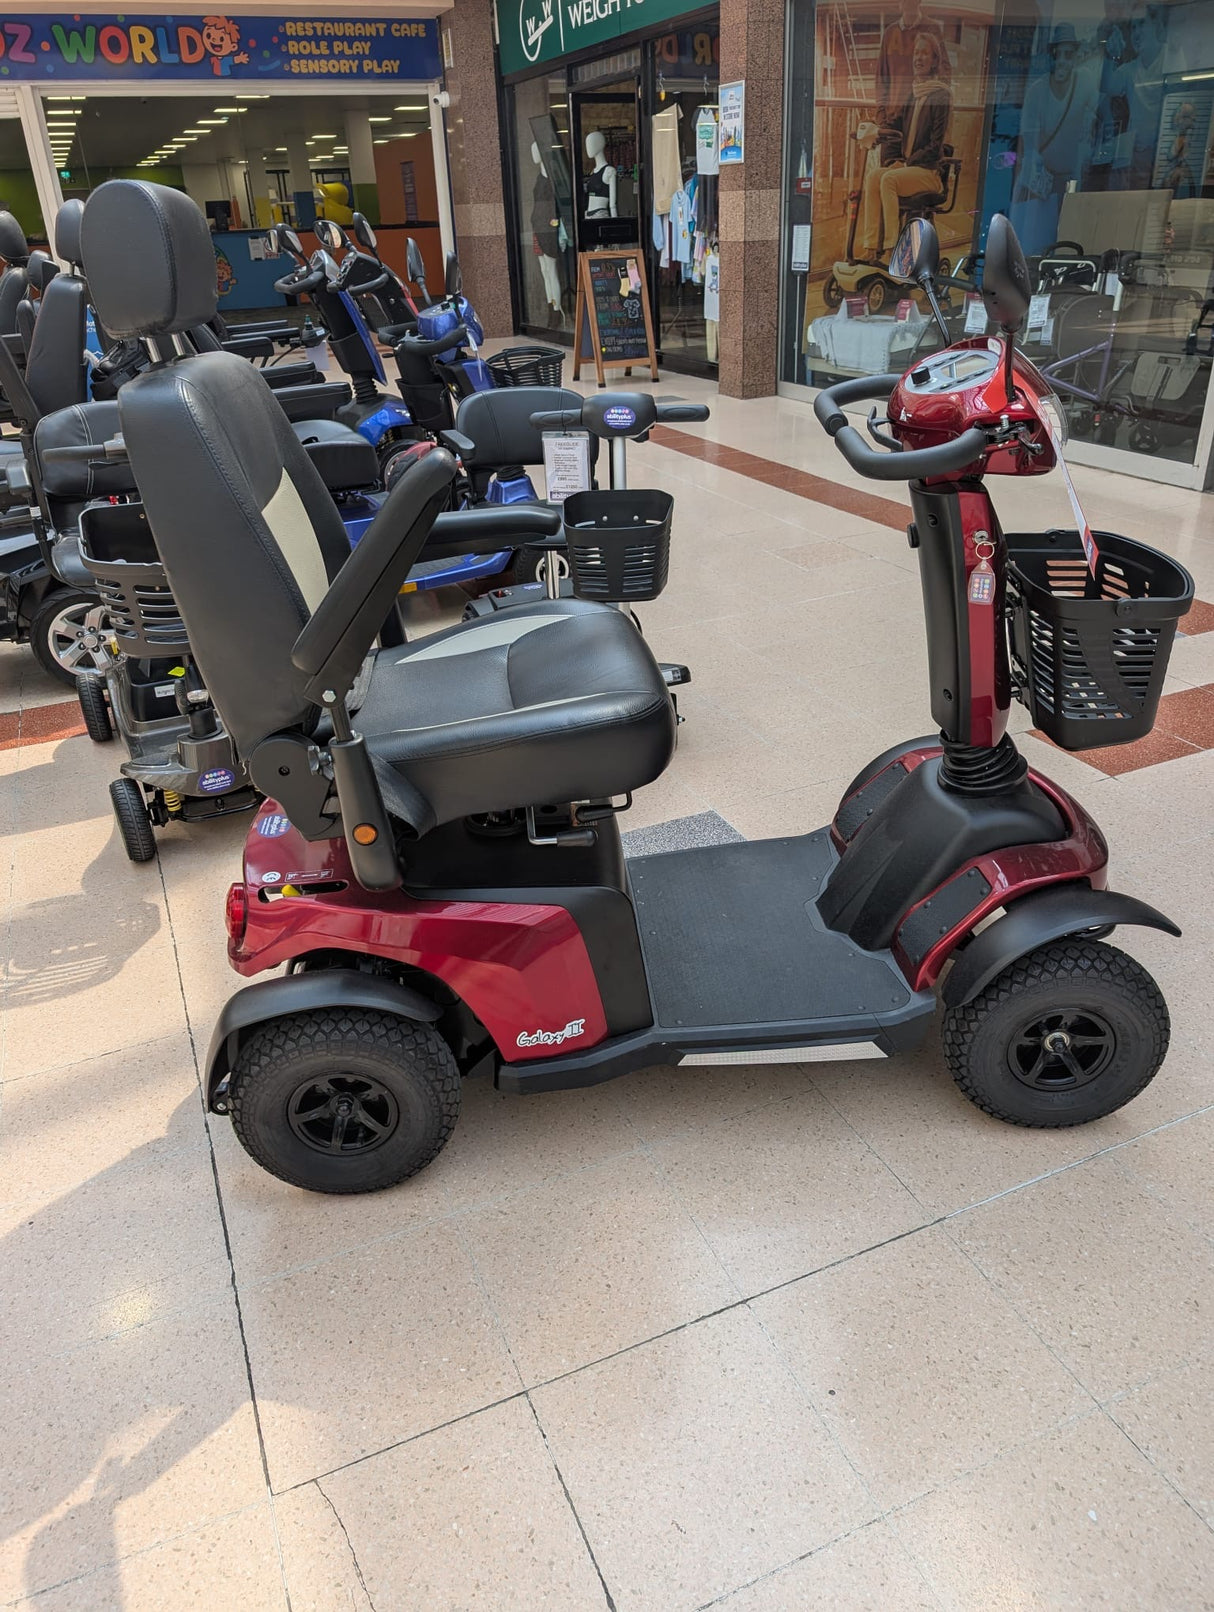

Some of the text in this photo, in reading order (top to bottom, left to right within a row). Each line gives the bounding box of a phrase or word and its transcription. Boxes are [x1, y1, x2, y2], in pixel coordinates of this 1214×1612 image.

[285, 22, 427, 37] RESTAURANT CAFE
[0, 23, 206, 64] Z WORLD
[288, 41, 371, 55] ROLE PLAY
[290, 59, 400, 73] SENSORY PLAY
[517, 1029, 565, 1047] Galaxy
